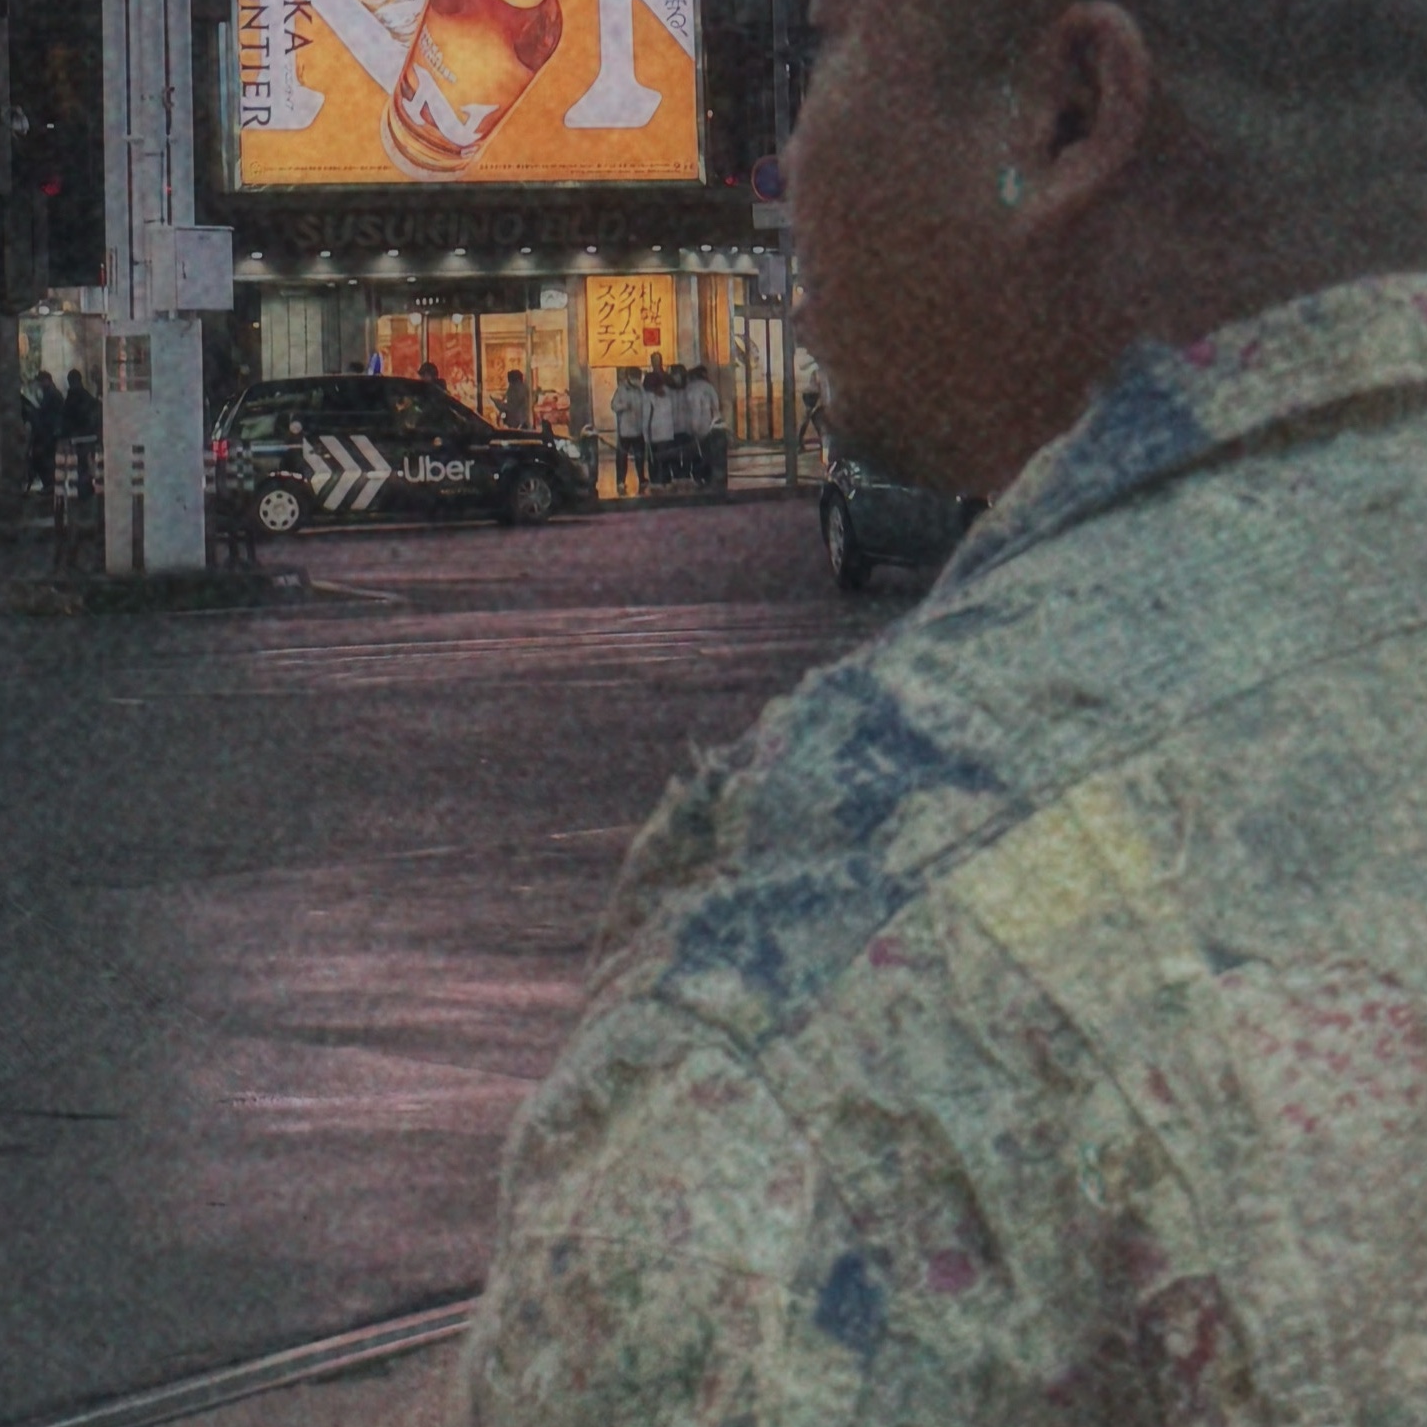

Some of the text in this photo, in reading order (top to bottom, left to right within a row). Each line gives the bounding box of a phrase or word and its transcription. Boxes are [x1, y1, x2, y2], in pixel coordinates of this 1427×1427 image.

[595, 283, 616, 357] スクエア
[402, 455, 475, 484] Uber
